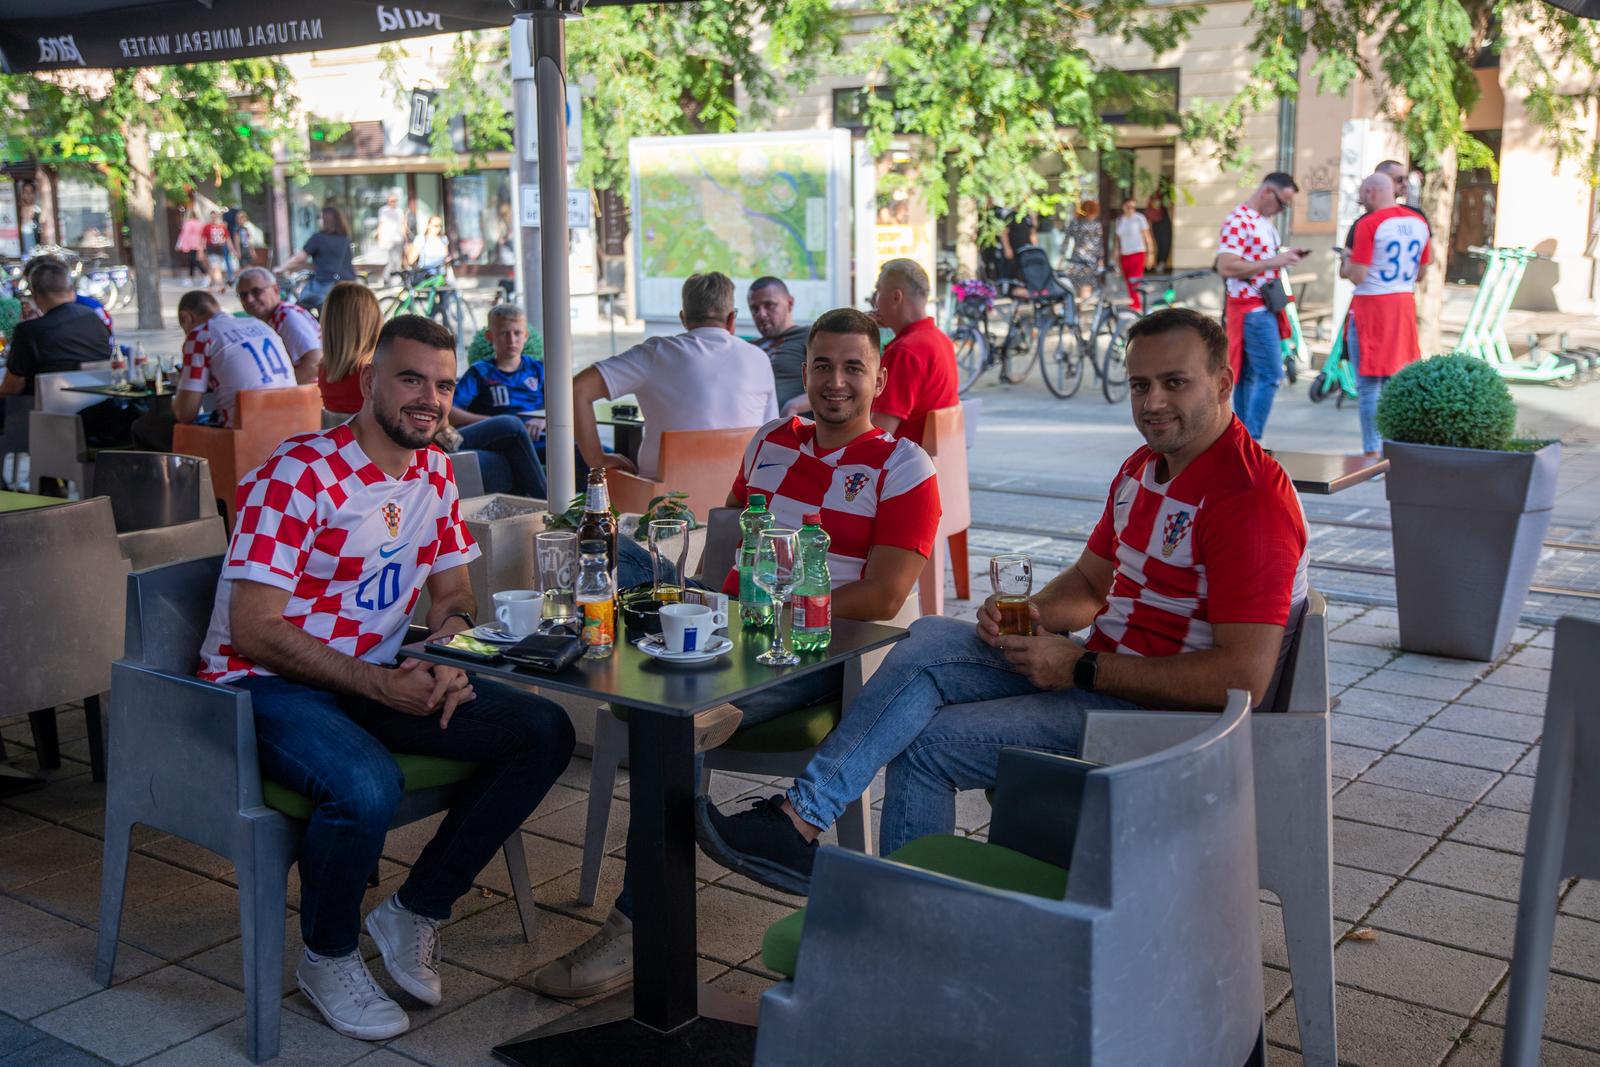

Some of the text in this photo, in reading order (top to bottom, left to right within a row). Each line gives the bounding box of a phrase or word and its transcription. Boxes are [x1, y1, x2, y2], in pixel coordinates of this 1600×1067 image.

[1379, 239, 1421, 282] 33
[241, 337, 289, 384] 14
[490, 385, 510, 407] 10
[355, 562, 402, 611] 20
